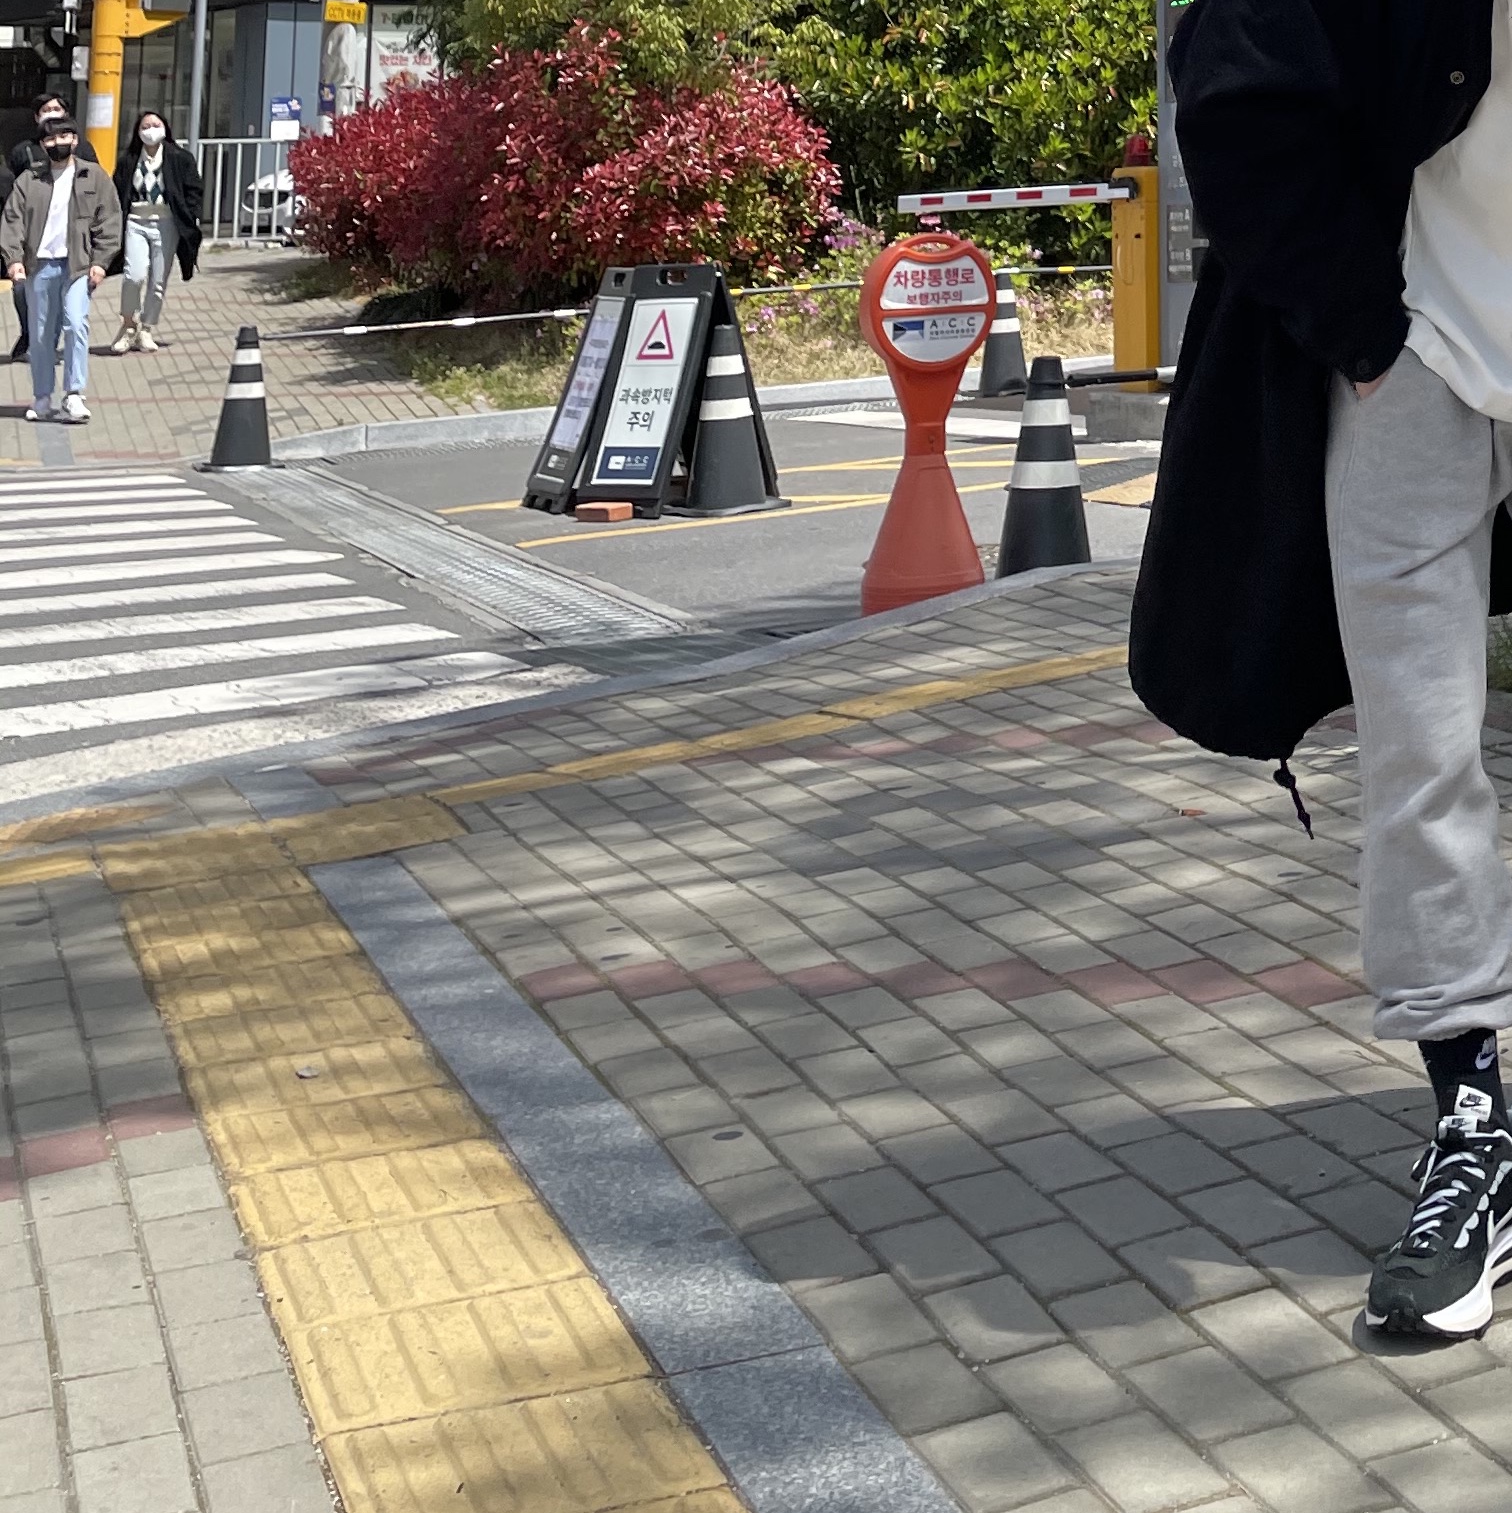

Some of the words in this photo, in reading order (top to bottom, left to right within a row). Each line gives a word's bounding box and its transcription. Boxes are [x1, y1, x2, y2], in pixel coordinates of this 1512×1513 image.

[893, 267, 976, 289] 차량통행로
[906, 289, 963, 306] 보행자주의
[619, 387, 674, 405] 과속방지턱
[626, 410, 656, 432] 주의
